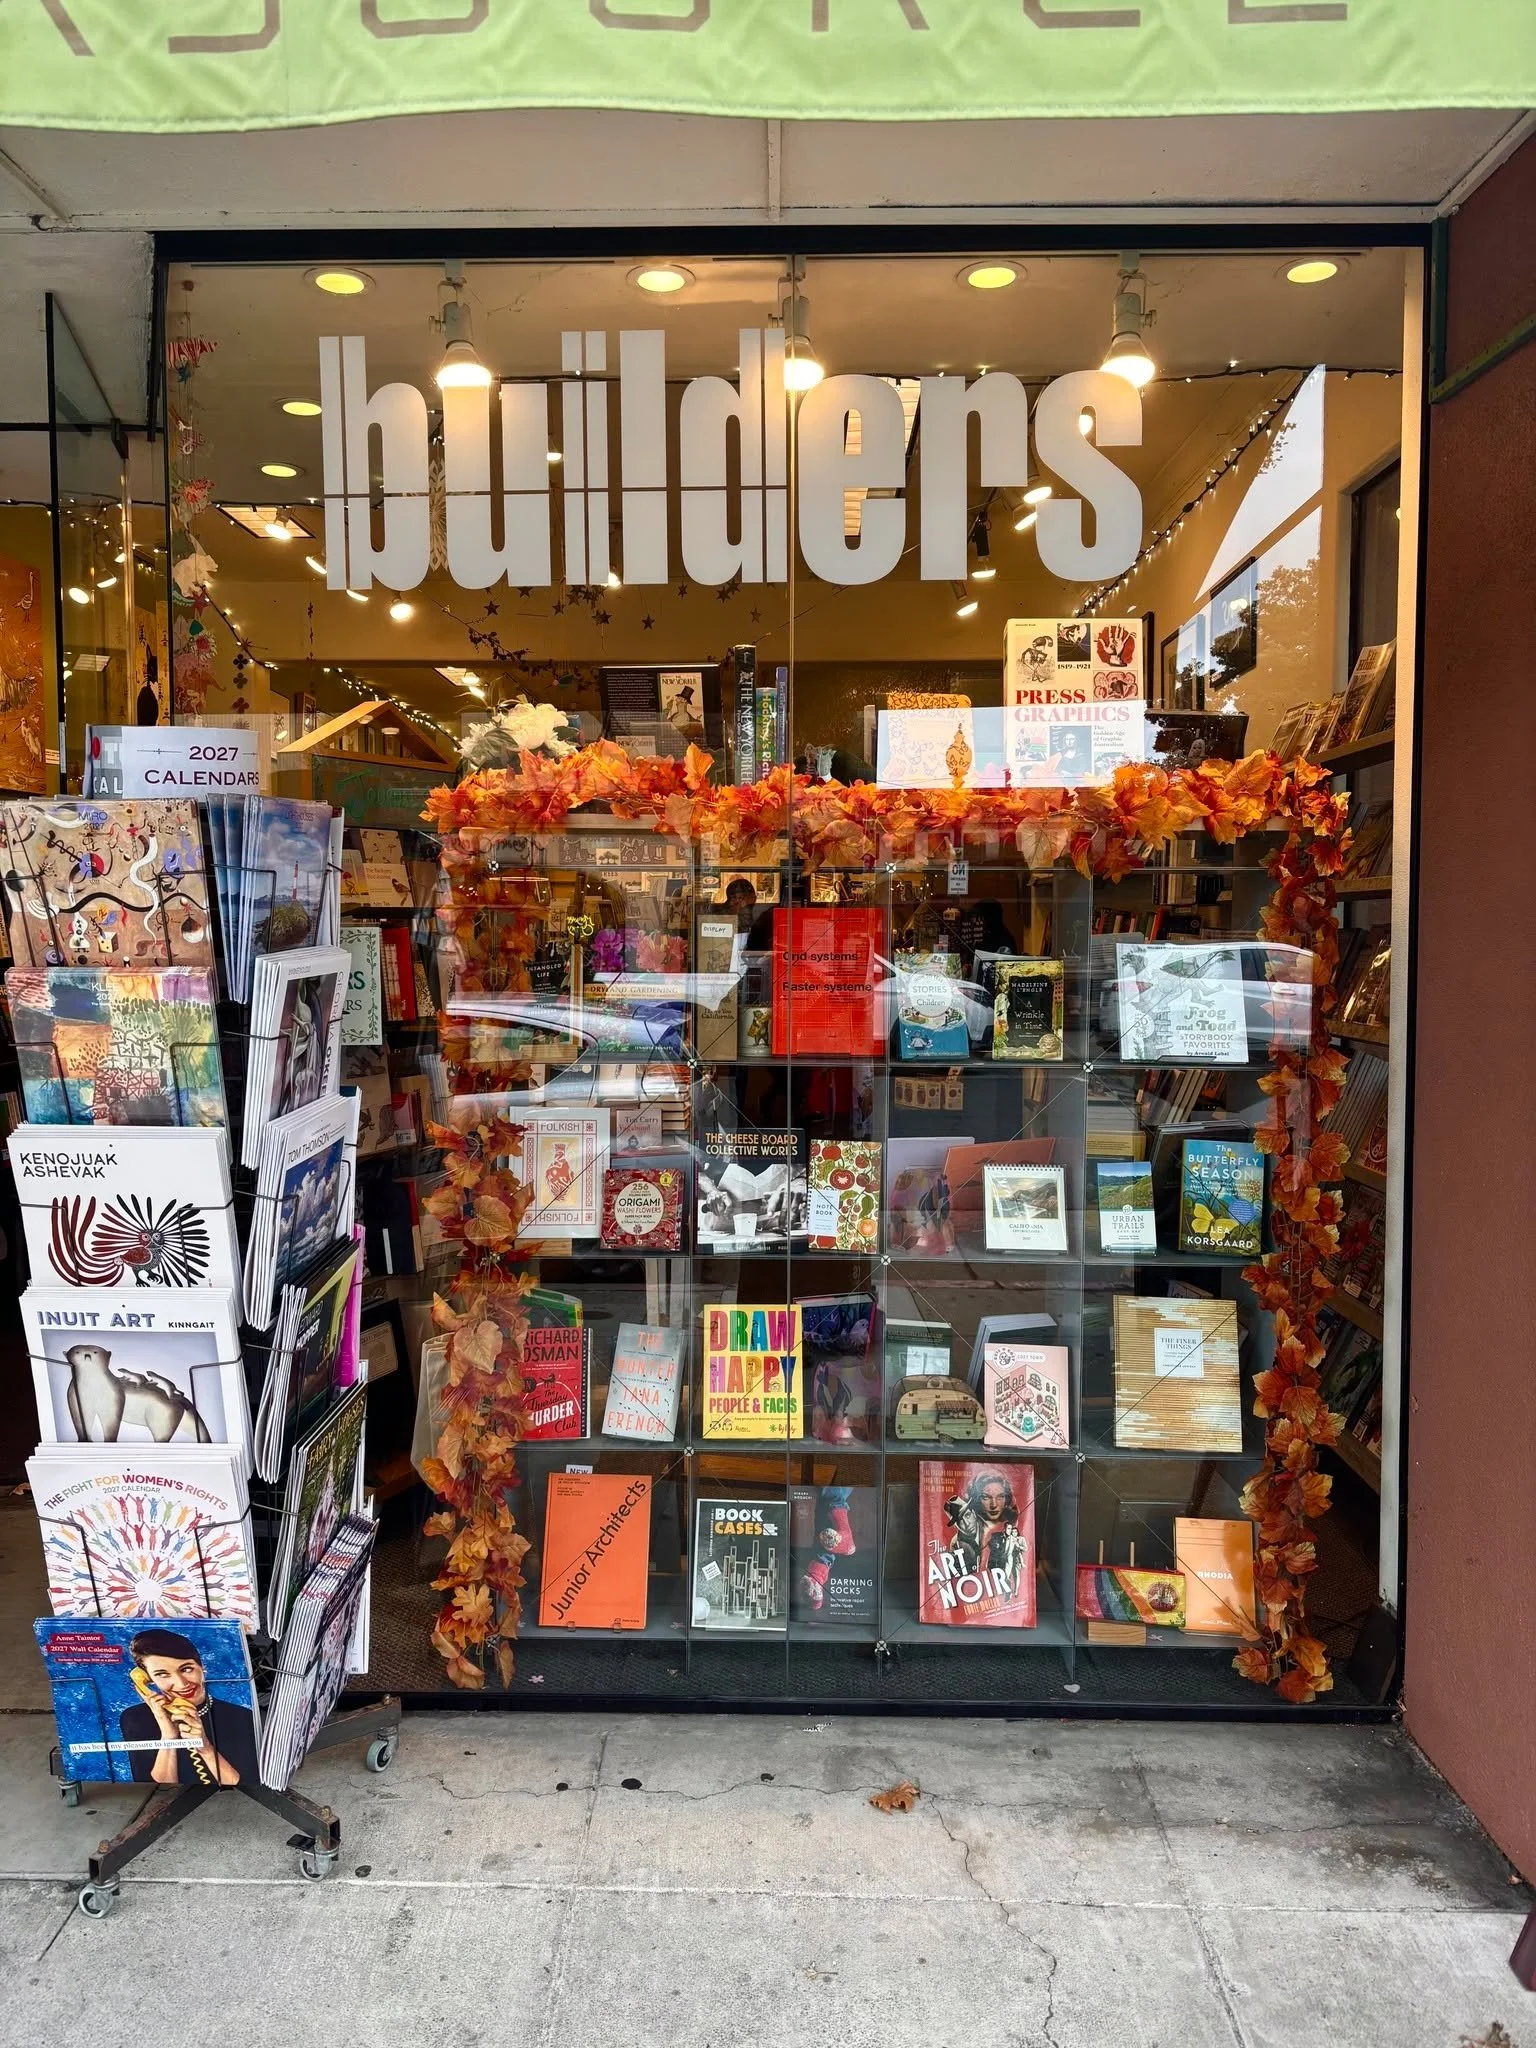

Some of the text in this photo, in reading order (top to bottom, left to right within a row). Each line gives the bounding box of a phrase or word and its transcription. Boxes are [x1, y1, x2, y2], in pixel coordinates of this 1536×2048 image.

[319, 328, 1144, 591] builders
[741, 678, 754, 703] THE
[1015, 688, 1086, 705] PRESS
[741, 705, 755, 737] NEW
[1014, 706, 1130, 722] GRAPHICS
[189, 746, 239, 761] 2027
[144, 769, 260, 786] CALENDARS
[783, 951, 858, 963] Grid systems
[630, 986, 678, 994] GARDENING
[783, 982, 872, 993] Raster systeme
[912, 985, 948, 994] STORIES
[916, 998, 946, 1006] Children
[1026, 1000, 1033, 1008] A
[1014, 1009, 1045, 1019] Wrinkle
[1184, 1006, 1227, 1020] Frog
[1023, 1021, 1043, 1030] Time
[1175, 1020, 1237, 1032] and Toad
[1179, 1033, 1234, 1041] STORYBOOK
[1183, 1041, 1231, 1049] FAVORITES
[540, 1123, 580, 1132] FOLKISH
[302, 1132, 330, 1157] THOMSON
[705, 1132, 723, 1144] THE
[726, 1133, 760, 1145] CHEESE
[705, 1144, 759, 1156] COLLECTIVE
[19, 1152, 118, 1166] KENOJUAK
[1188, 1154, 1260, 1167] BUTTERFLY
[22, 1165, 106, 1179] ASHEVAK
[1191, 1167, 1255, 1181] SEASON
[632, 1183, 649, 1191] 256
[619, 1198, 661, 1206] ORIGAMI
[539, 1212, 579, 1222] FOLKISH
[1111, 1222, 1145, 1230] TRAILS
[1210, 1225, 1231, 1235] LEA
[1186, 1235, 1254, 1249] KORSGAARD
[36, 1310, 216, 1329] INUIT ART KINNGAIT
[709, 1310, 797, 1352] DRAW
[709, 1355, 797, 1394] HAPPY
[623, 1385, 660, 1406] TANA
[709, 1397, 750, 1414] PEOPLE
[752, 1398, 761, 1414] &
[554, 1417, 577, 1434] Club
[607, 1411, 666, 1434] FRENCH
[43, 1474, 230, 1511] THE FIGHT FOR WOMEN'S RIGHTS
[102, 1485, 161, 1494] 2027 CALENDAR
[715, 1508, 764, 1522] BOOK
[714, 1521, 763, 1536] CASES
[550, 1480, 647, 1620] Junior Architects
[927, 1539, 947, 1556] The
[928, 1548, 968, 1585] ART
[830, 1578, 873, 1587] DARNING
[1197, 1571, 1234, 1581] RHODIA
[830, 1586, 861, 1595] SOCKS
[938, 1567, 1012, 1610] NOIR
[123, 1742, 153, 1750] pleasure
[164, 1740, 186, 1749] ignore
[187, 1740, 202, 1748] you
